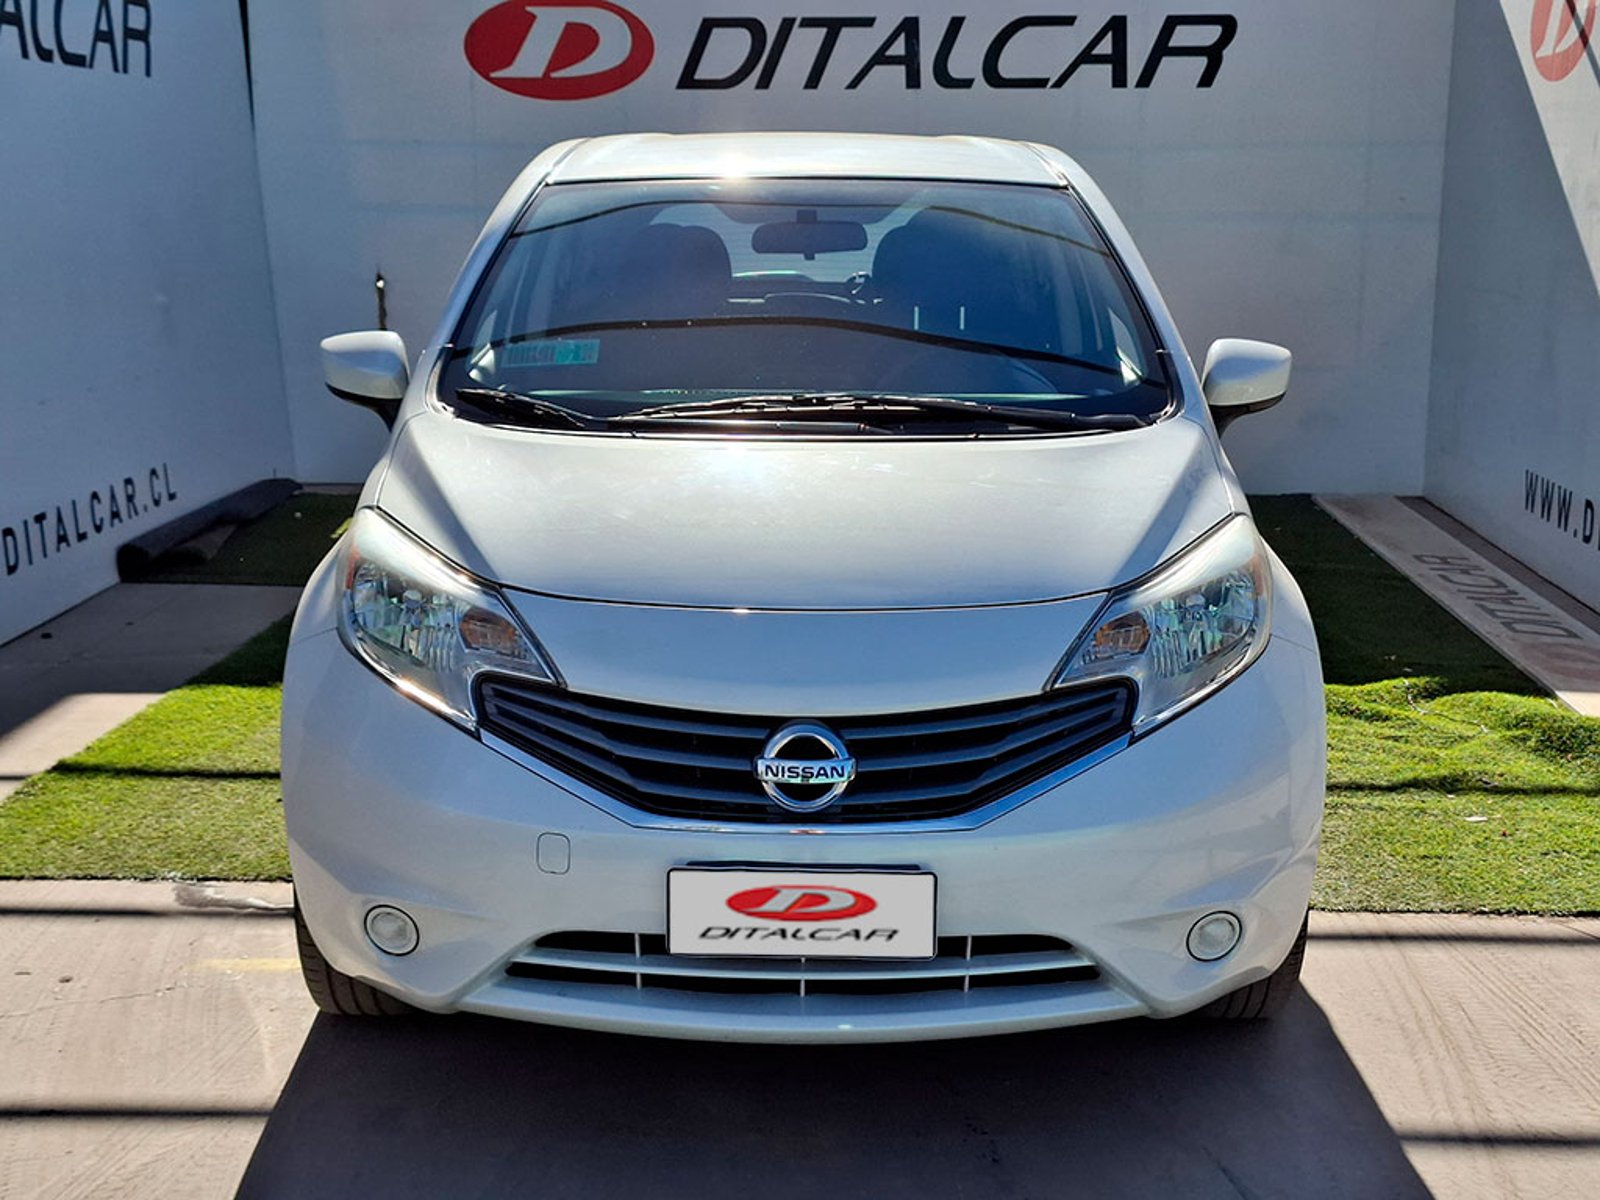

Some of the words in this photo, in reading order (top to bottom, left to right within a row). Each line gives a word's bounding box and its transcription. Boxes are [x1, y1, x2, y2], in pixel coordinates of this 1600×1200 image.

[676, 14, 1238, 89] DITALCAR
[2, 462, 177, 576] DITALCAR.CL
[764, 764, 845, 779] NISSAN
[698, 926, 899, 942] DITALCAR
